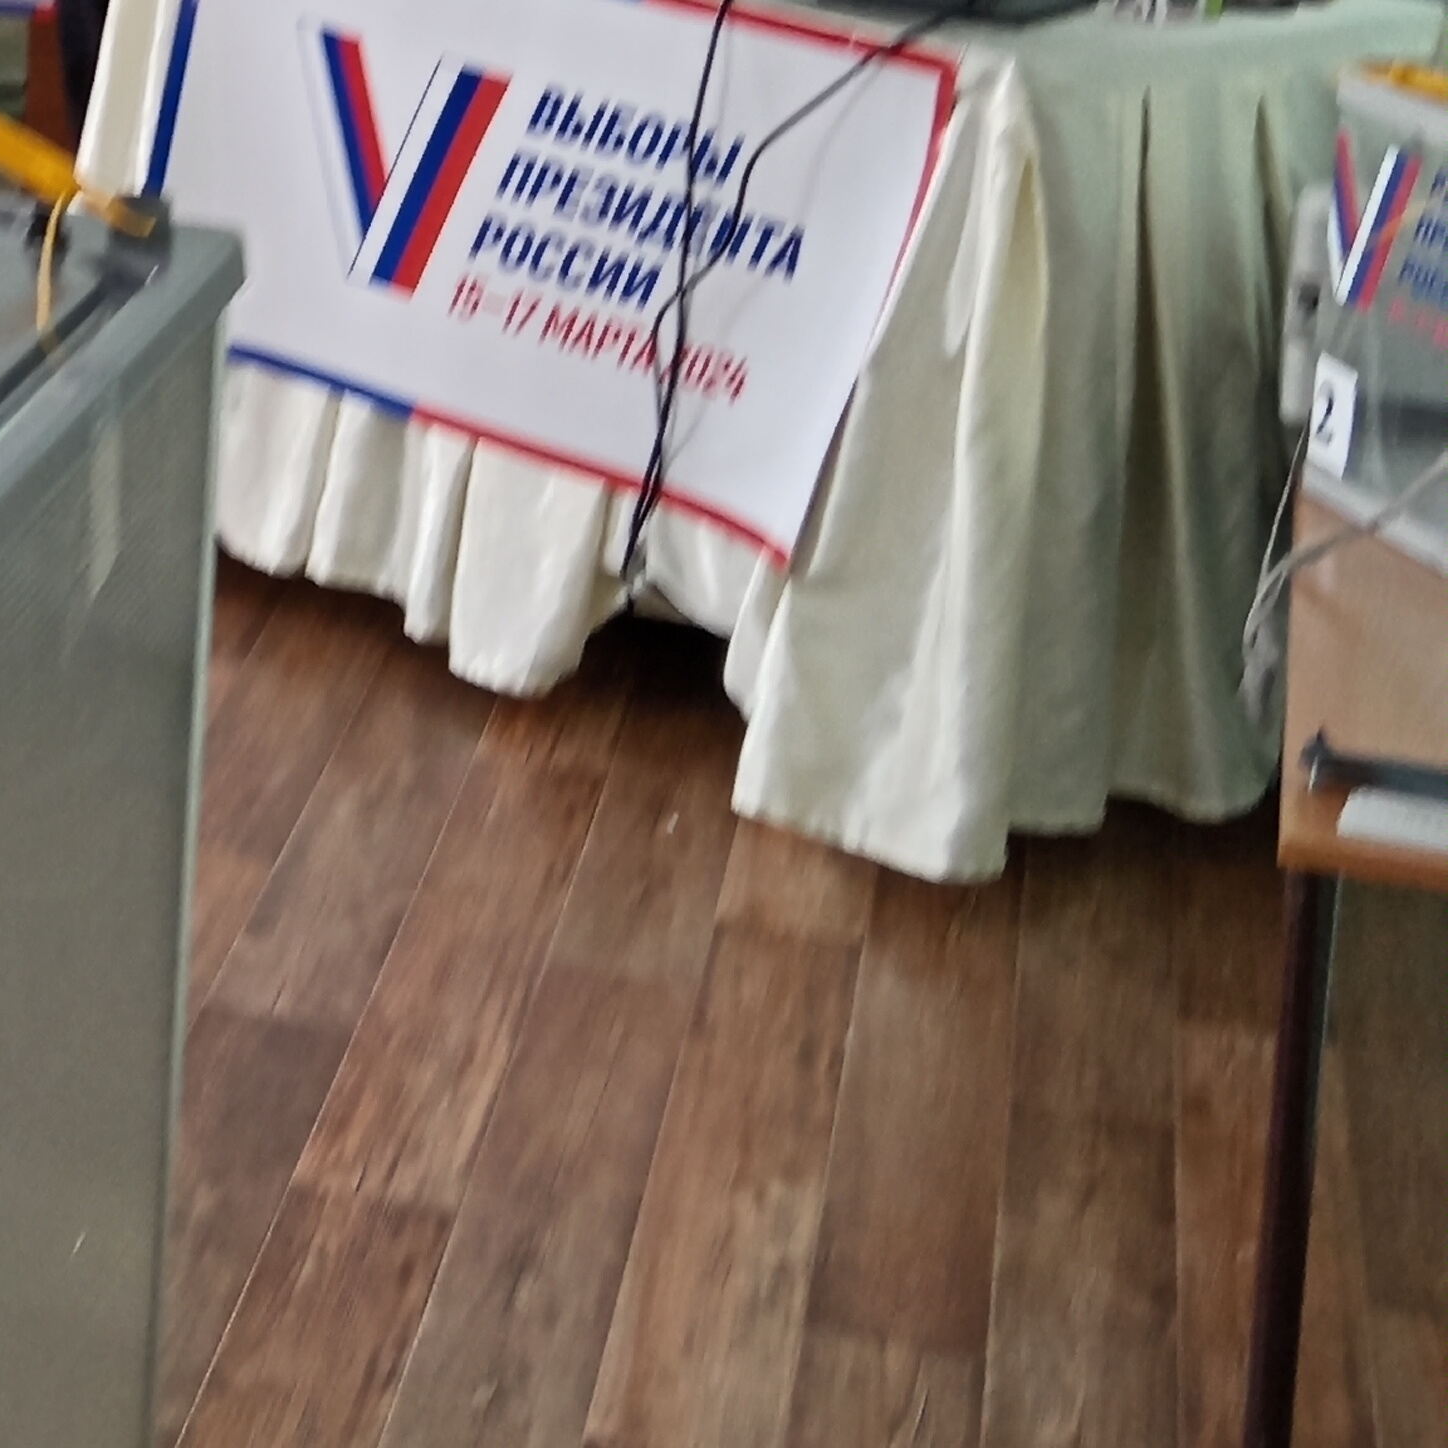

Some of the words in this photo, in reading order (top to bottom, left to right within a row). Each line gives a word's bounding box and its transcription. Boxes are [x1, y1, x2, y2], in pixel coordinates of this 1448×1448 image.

[526, 83, 746, 189] ВЫБОРЫ
[467, 211, 664, 314] РОССИИ
[495, 147, 804, 286] ПРЕЗИДЕНТА
[539, 302, 658, 376] МАРТА
